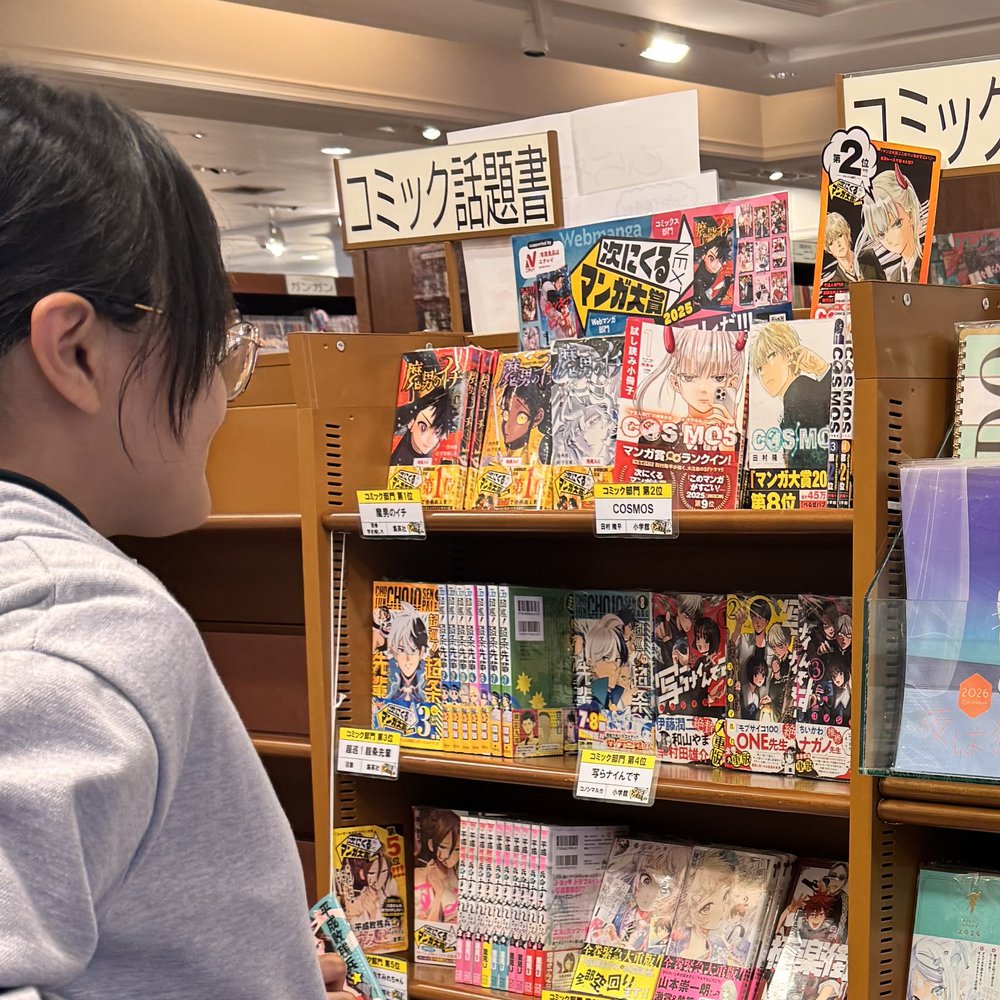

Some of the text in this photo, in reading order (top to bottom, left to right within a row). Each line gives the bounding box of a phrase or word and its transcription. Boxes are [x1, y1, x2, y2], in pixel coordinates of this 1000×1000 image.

[345, 144, 550, 234] コミック話題書
[600, 240, 672, 284] 次にくる
[580, 265, 668, 316] マンガ大賞
[662, 302, 694, 326] 2025
[624, 325, 640, 396] 試し読み小冊子
[831, 347, 845, 433] COSMOS
[397, 492, 414, 501] 第1位
[602, 486, 663, 496] コミック部門 第2位
[751, 492, 796, 509] 第8位
[375, 507, 407, 518] 魔男のイチ
[612, 503, 654, 514] COSMOS
[600, 522, 611, 531] 田村
[633, 522, 650, 531] 小学館
[961, 687, 989, 699] 2026
[377, 733, 394, 743] 第3位
[671, 733, 710, 747] 和山やま
[736, 733, 788, 751] ONE先生
[589, 752, 647, 766] コミック部門 第4位
[591, 768, 641, 782] 写らナイんです
[612, 788, 628, 797] 小学館
